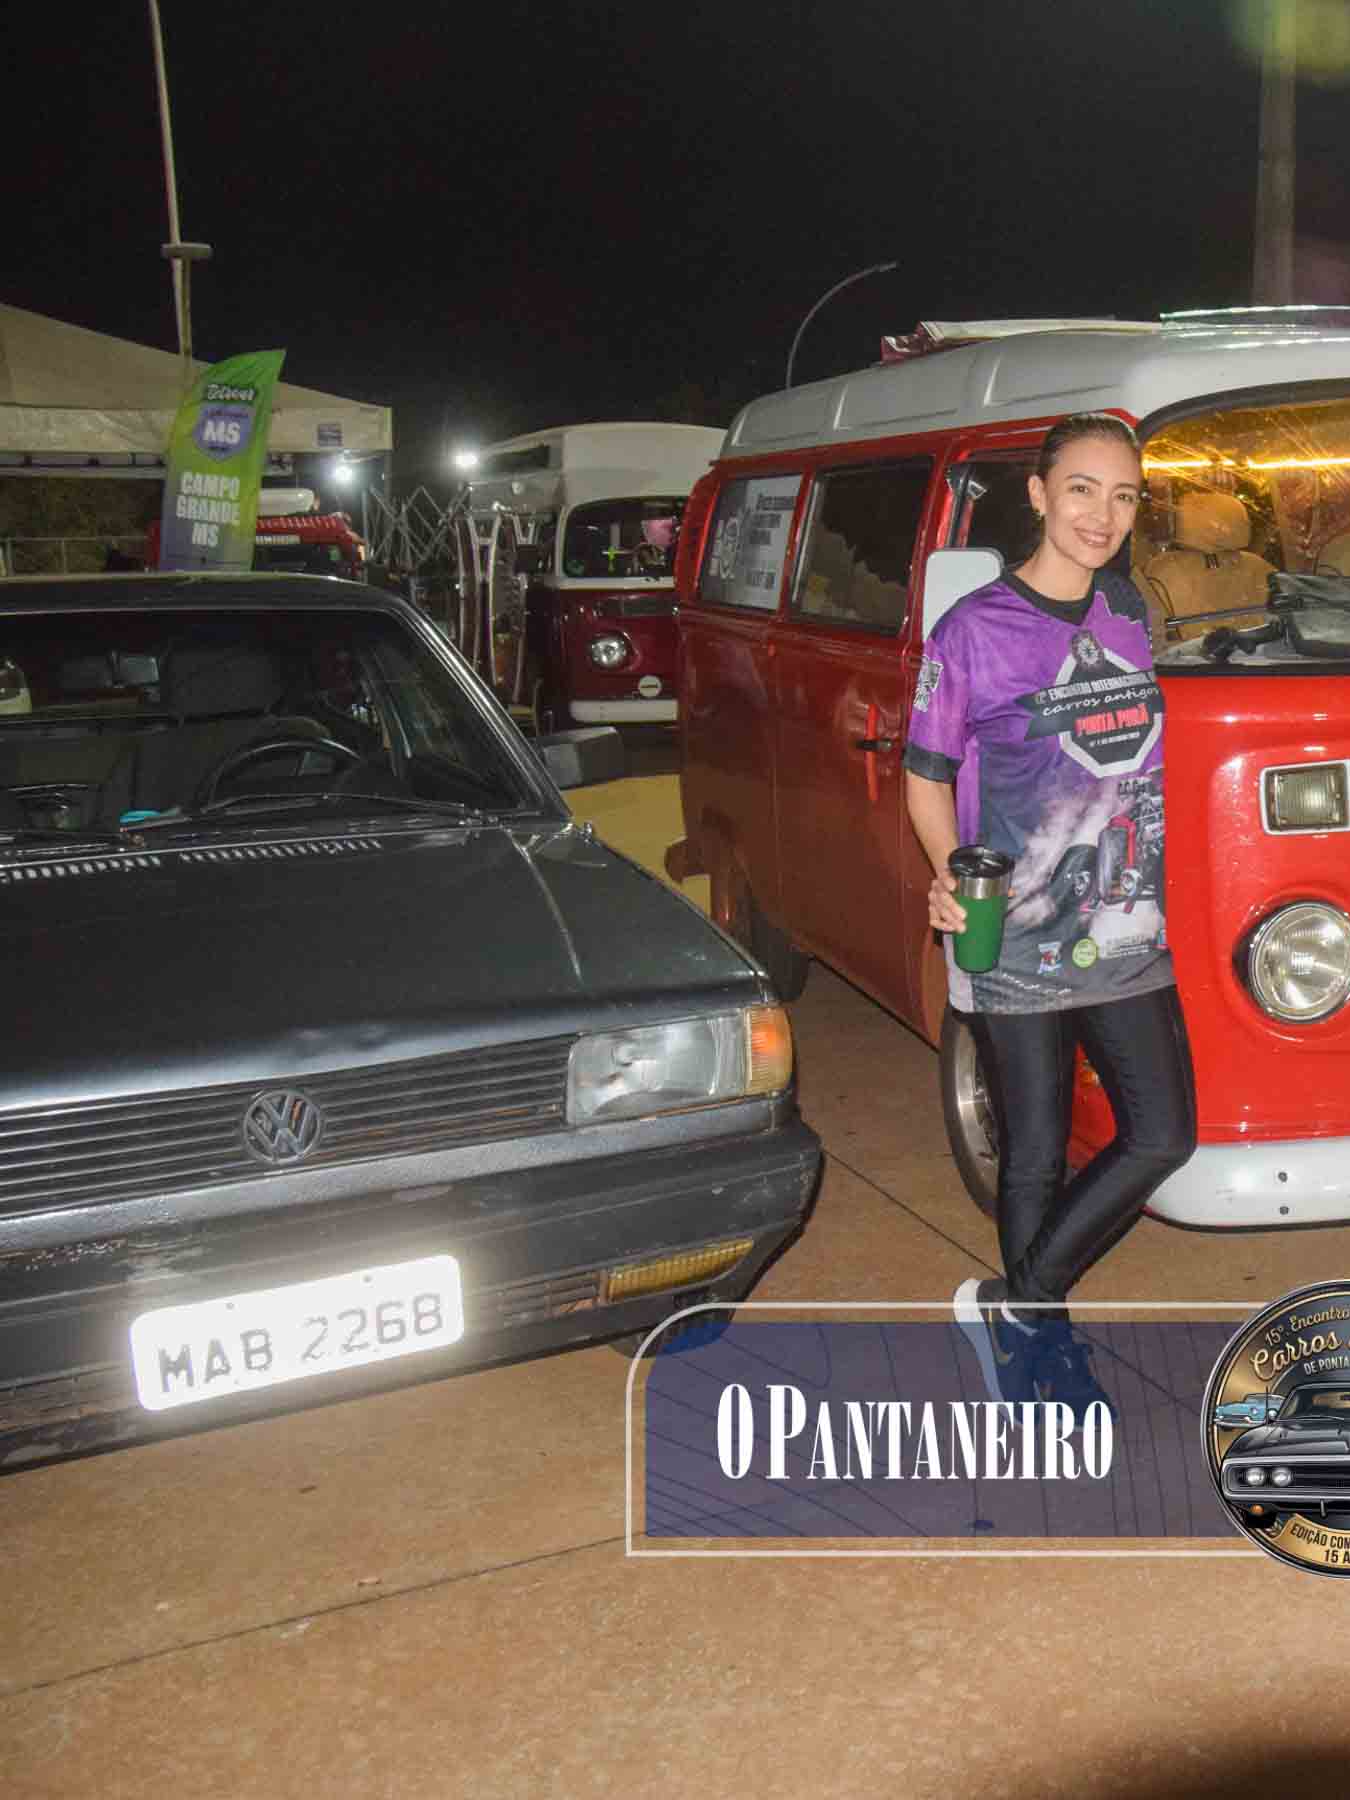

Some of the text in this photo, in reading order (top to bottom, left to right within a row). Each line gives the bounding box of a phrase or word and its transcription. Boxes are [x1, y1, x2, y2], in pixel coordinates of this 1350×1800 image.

[203, 419, 241, 445] MS
[180, 471, 240, 498] CAMPO
[176, 494, 241, 525] GRANDE
[191, 522, 219, 547] MS
[1042, 696, 1101, 716] carros
[1075, 711, 1117, 737] PONTA
[157, 1292, 443, 1394] MAB 2268
